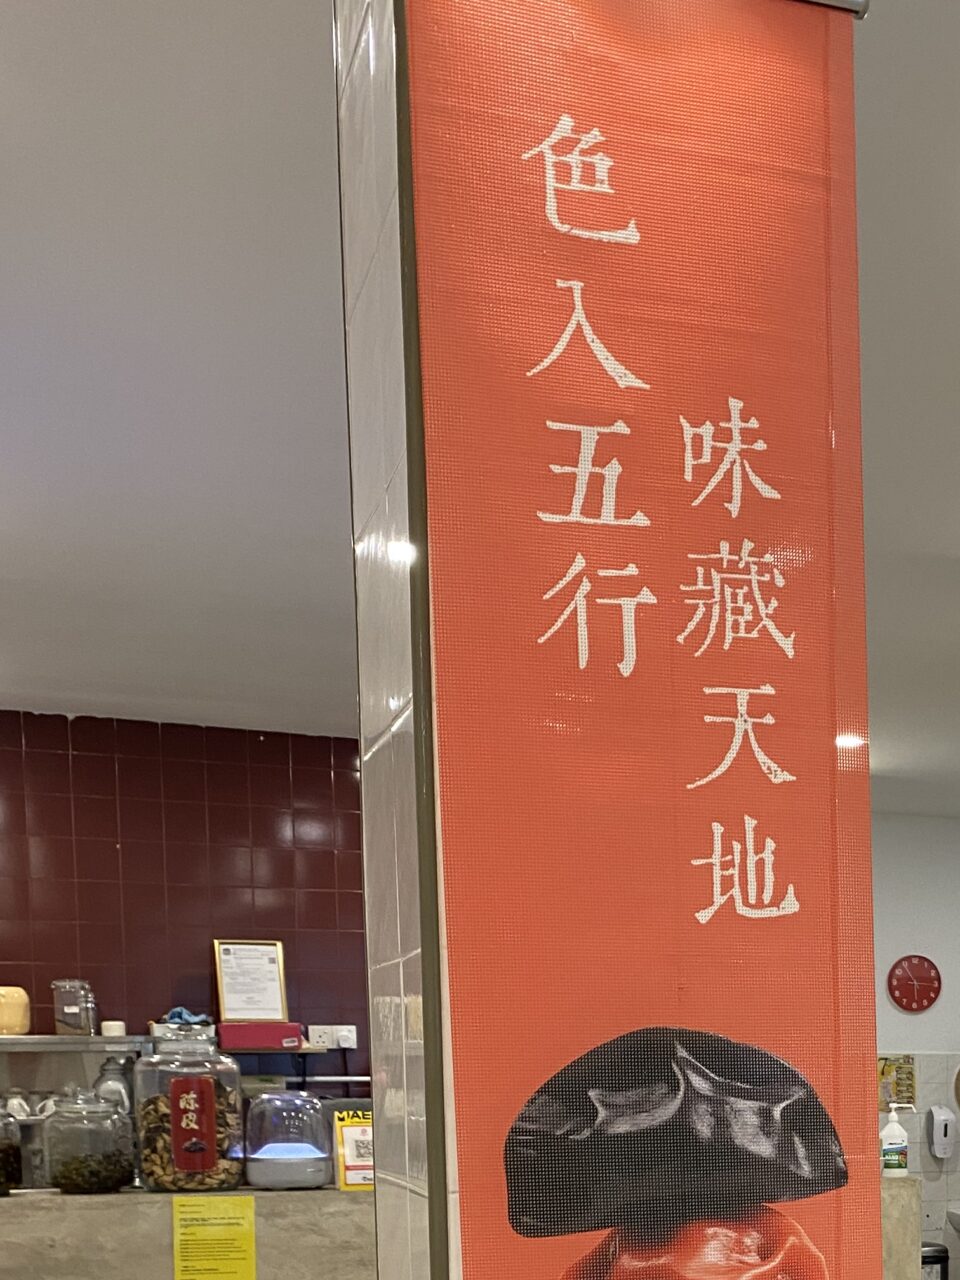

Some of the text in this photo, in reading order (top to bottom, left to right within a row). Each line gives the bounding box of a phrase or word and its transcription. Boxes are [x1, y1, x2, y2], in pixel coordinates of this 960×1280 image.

[521, 113, 658, 677] 色入五行
[676, 395, 800, 924] 味藏天地
